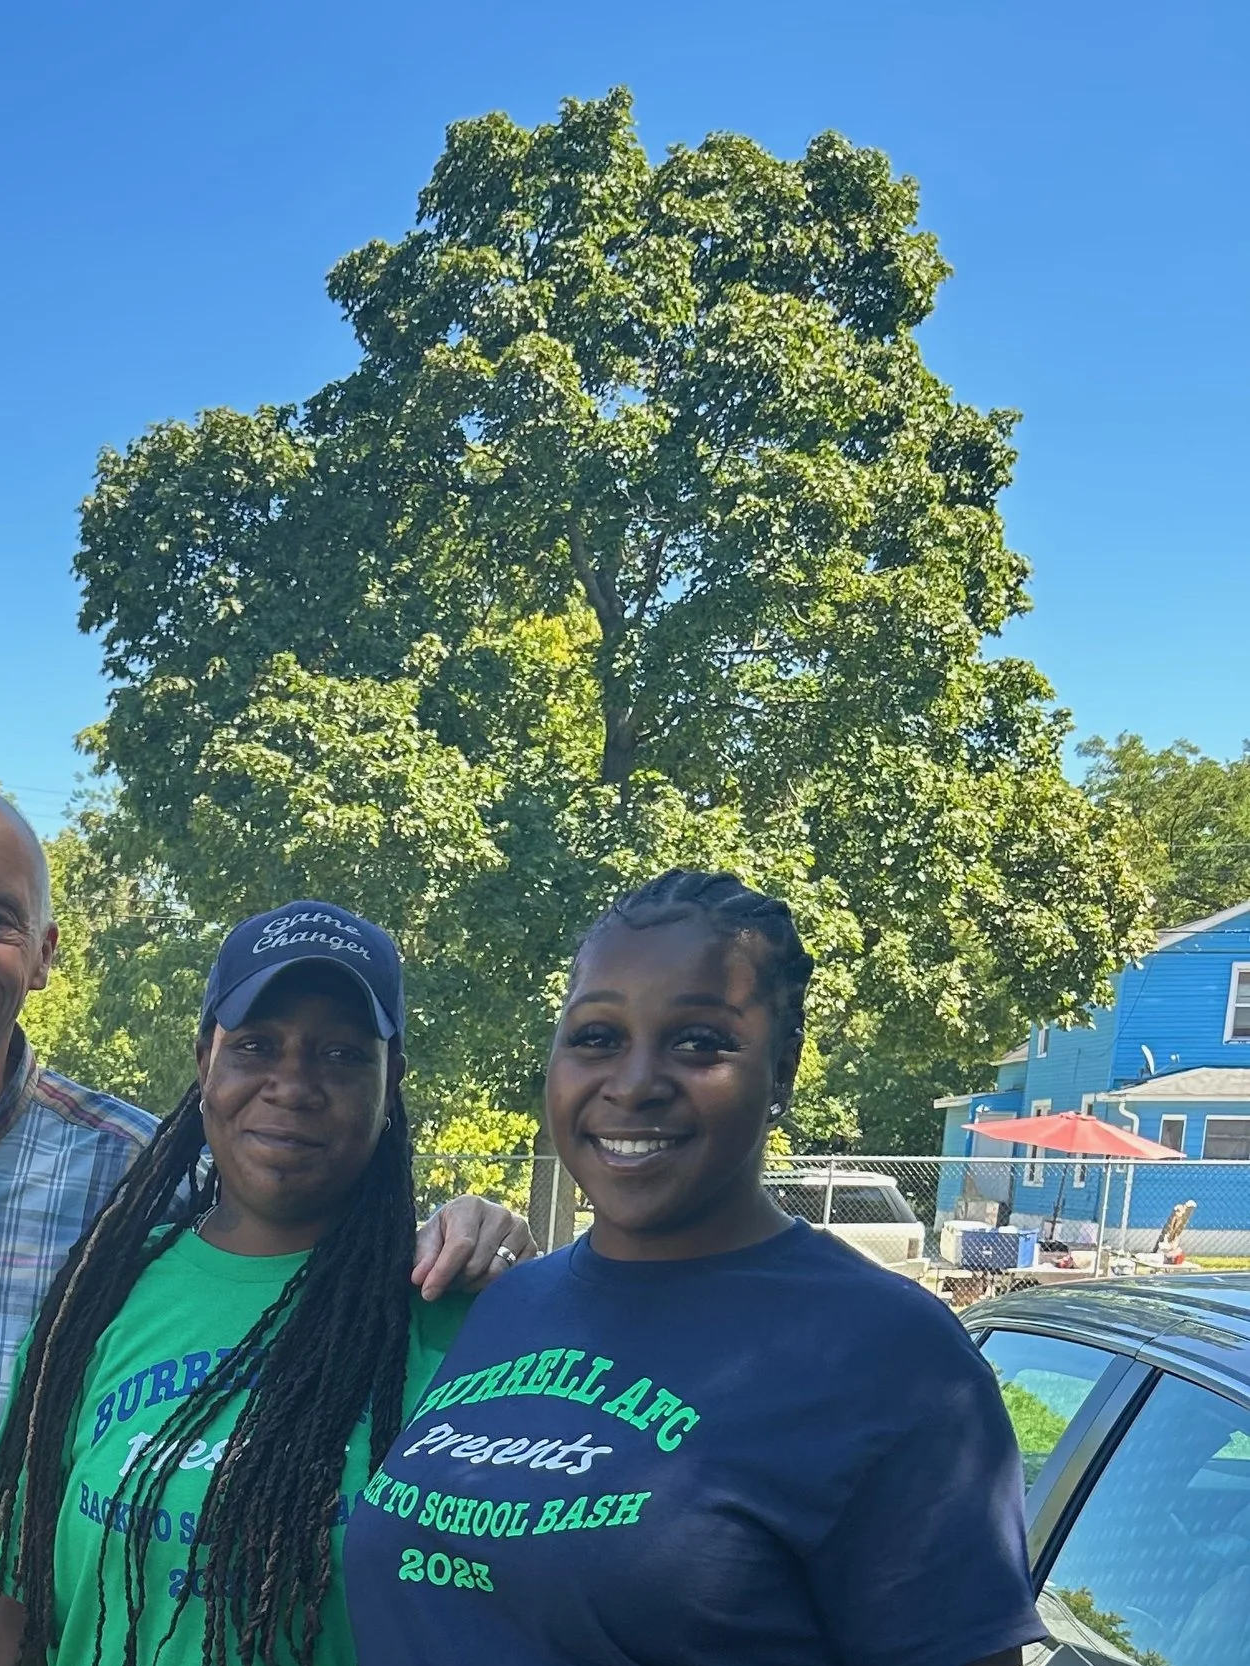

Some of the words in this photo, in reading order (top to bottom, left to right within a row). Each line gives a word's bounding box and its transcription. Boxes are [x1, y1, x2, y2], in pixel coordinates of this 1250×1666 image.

[252, 931, 372, 961] Changer
[262, 912, 362, 937] Game
[405, 1346, 615, 1432] BURRELL
[600, 1376, 701, 1453] AFC
[402, 1422, 613, 1475] Presents
[382, 1480, 419, 1519] TO
[417, 1490, 530, 1538] SCHOOL
[531, 1490, 652, 1537] BASH
[398, 1548, 494, 1593] 2023
